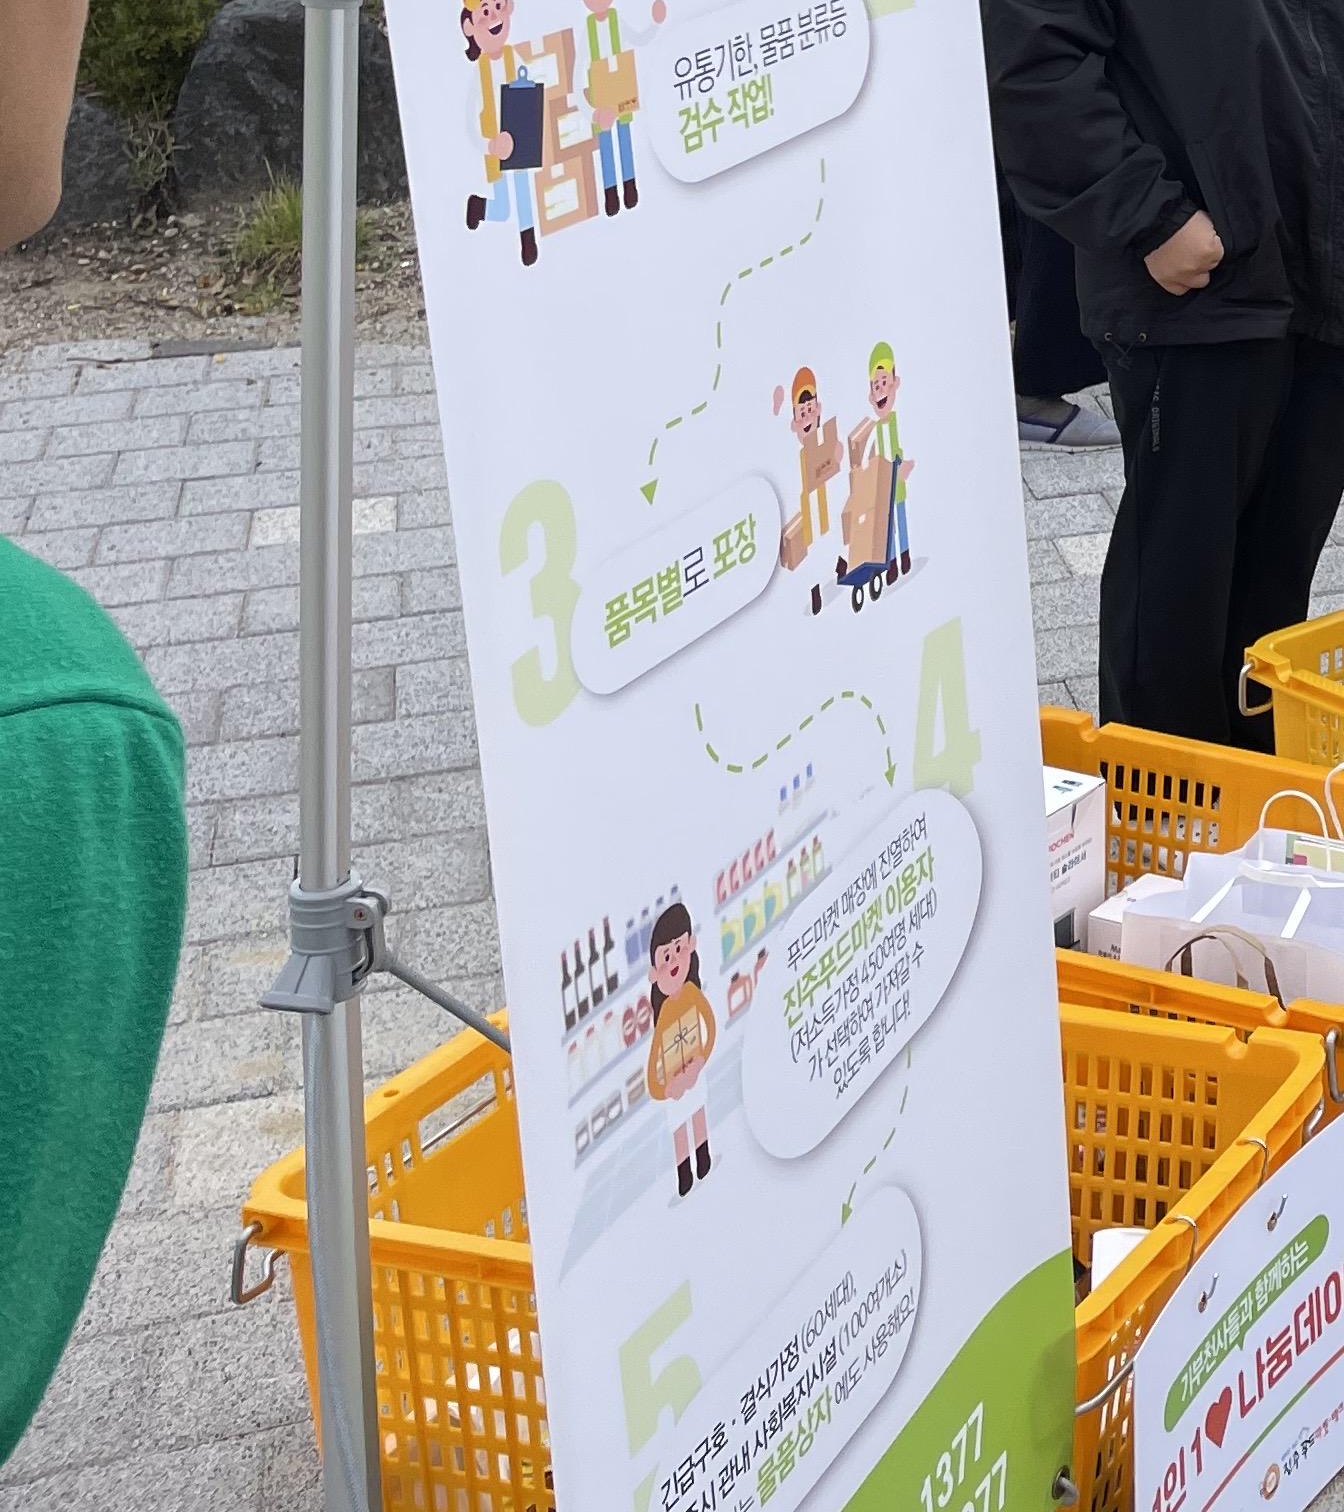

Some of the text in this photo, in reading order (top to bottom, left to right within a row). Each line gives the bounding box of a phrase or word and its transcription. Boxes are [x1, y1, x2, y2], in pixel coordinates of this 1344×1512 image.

[674, 31, 759, 101] 유통기한,
[760, 17, 795, 67] 물품
[678, 73, 775, 154] 검수 작업!
[604, 513, 758, 648] 품목별로 포장
[783, 845, 936, 1030] 진주푸드마켓 이용자
[787, 811, 929, 973] 푸드마켓 매장에 진열하여
[790, 887, 938, 1064] (저소득가정 450여명 세대)
[824, 993, 875, 1069] 선택하여
[832, 989, 912, 1100] 있도록 합니다!
[863, 1285, 916, 1371] 사용해요!
[1180, 1238, 1310, 1402] 기부천사들과 함께하는
[659, 1420, 729, 1512] 긴급구호
[717, 1440, 751, 1500] 관내
